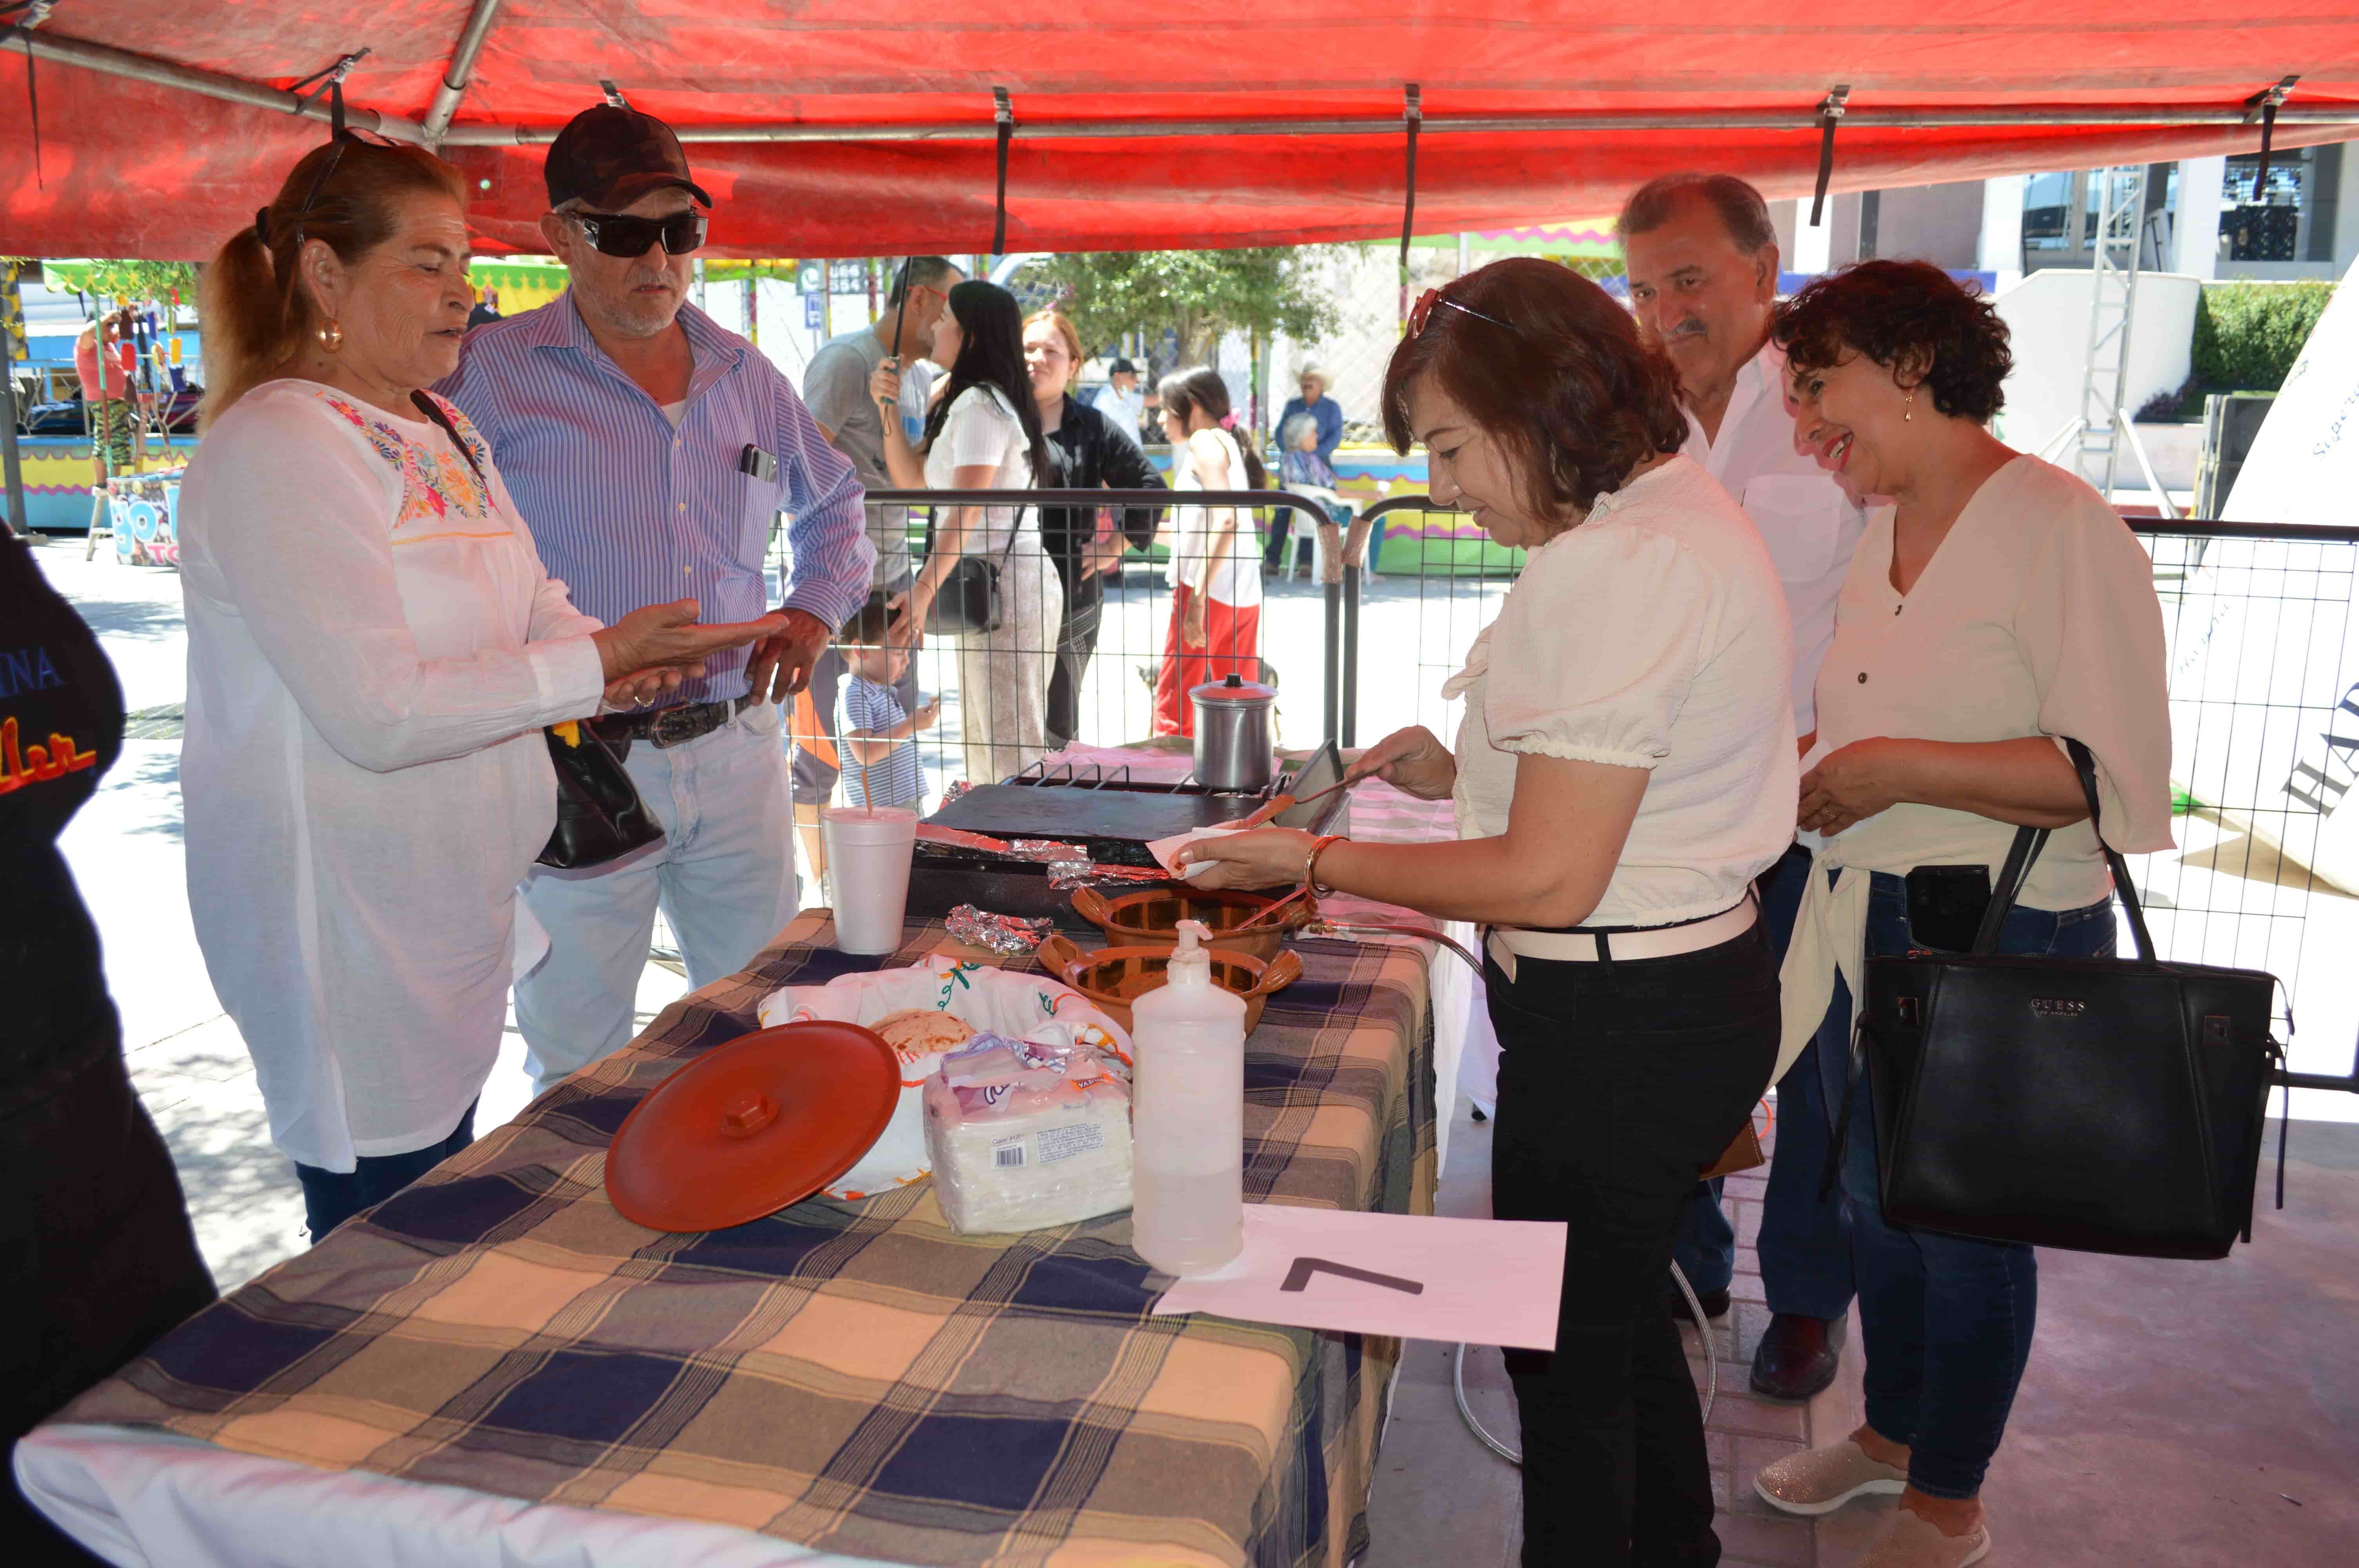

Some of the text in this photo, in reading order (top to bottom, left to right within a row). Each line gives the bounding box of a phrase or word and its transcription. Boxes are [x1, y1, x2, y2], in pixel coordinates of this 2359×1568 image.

[0, 716, 97, 795] ler
[2030, 998, 2085, 1011] GUESS
[1280, 1257, 1424, 1295] 7
